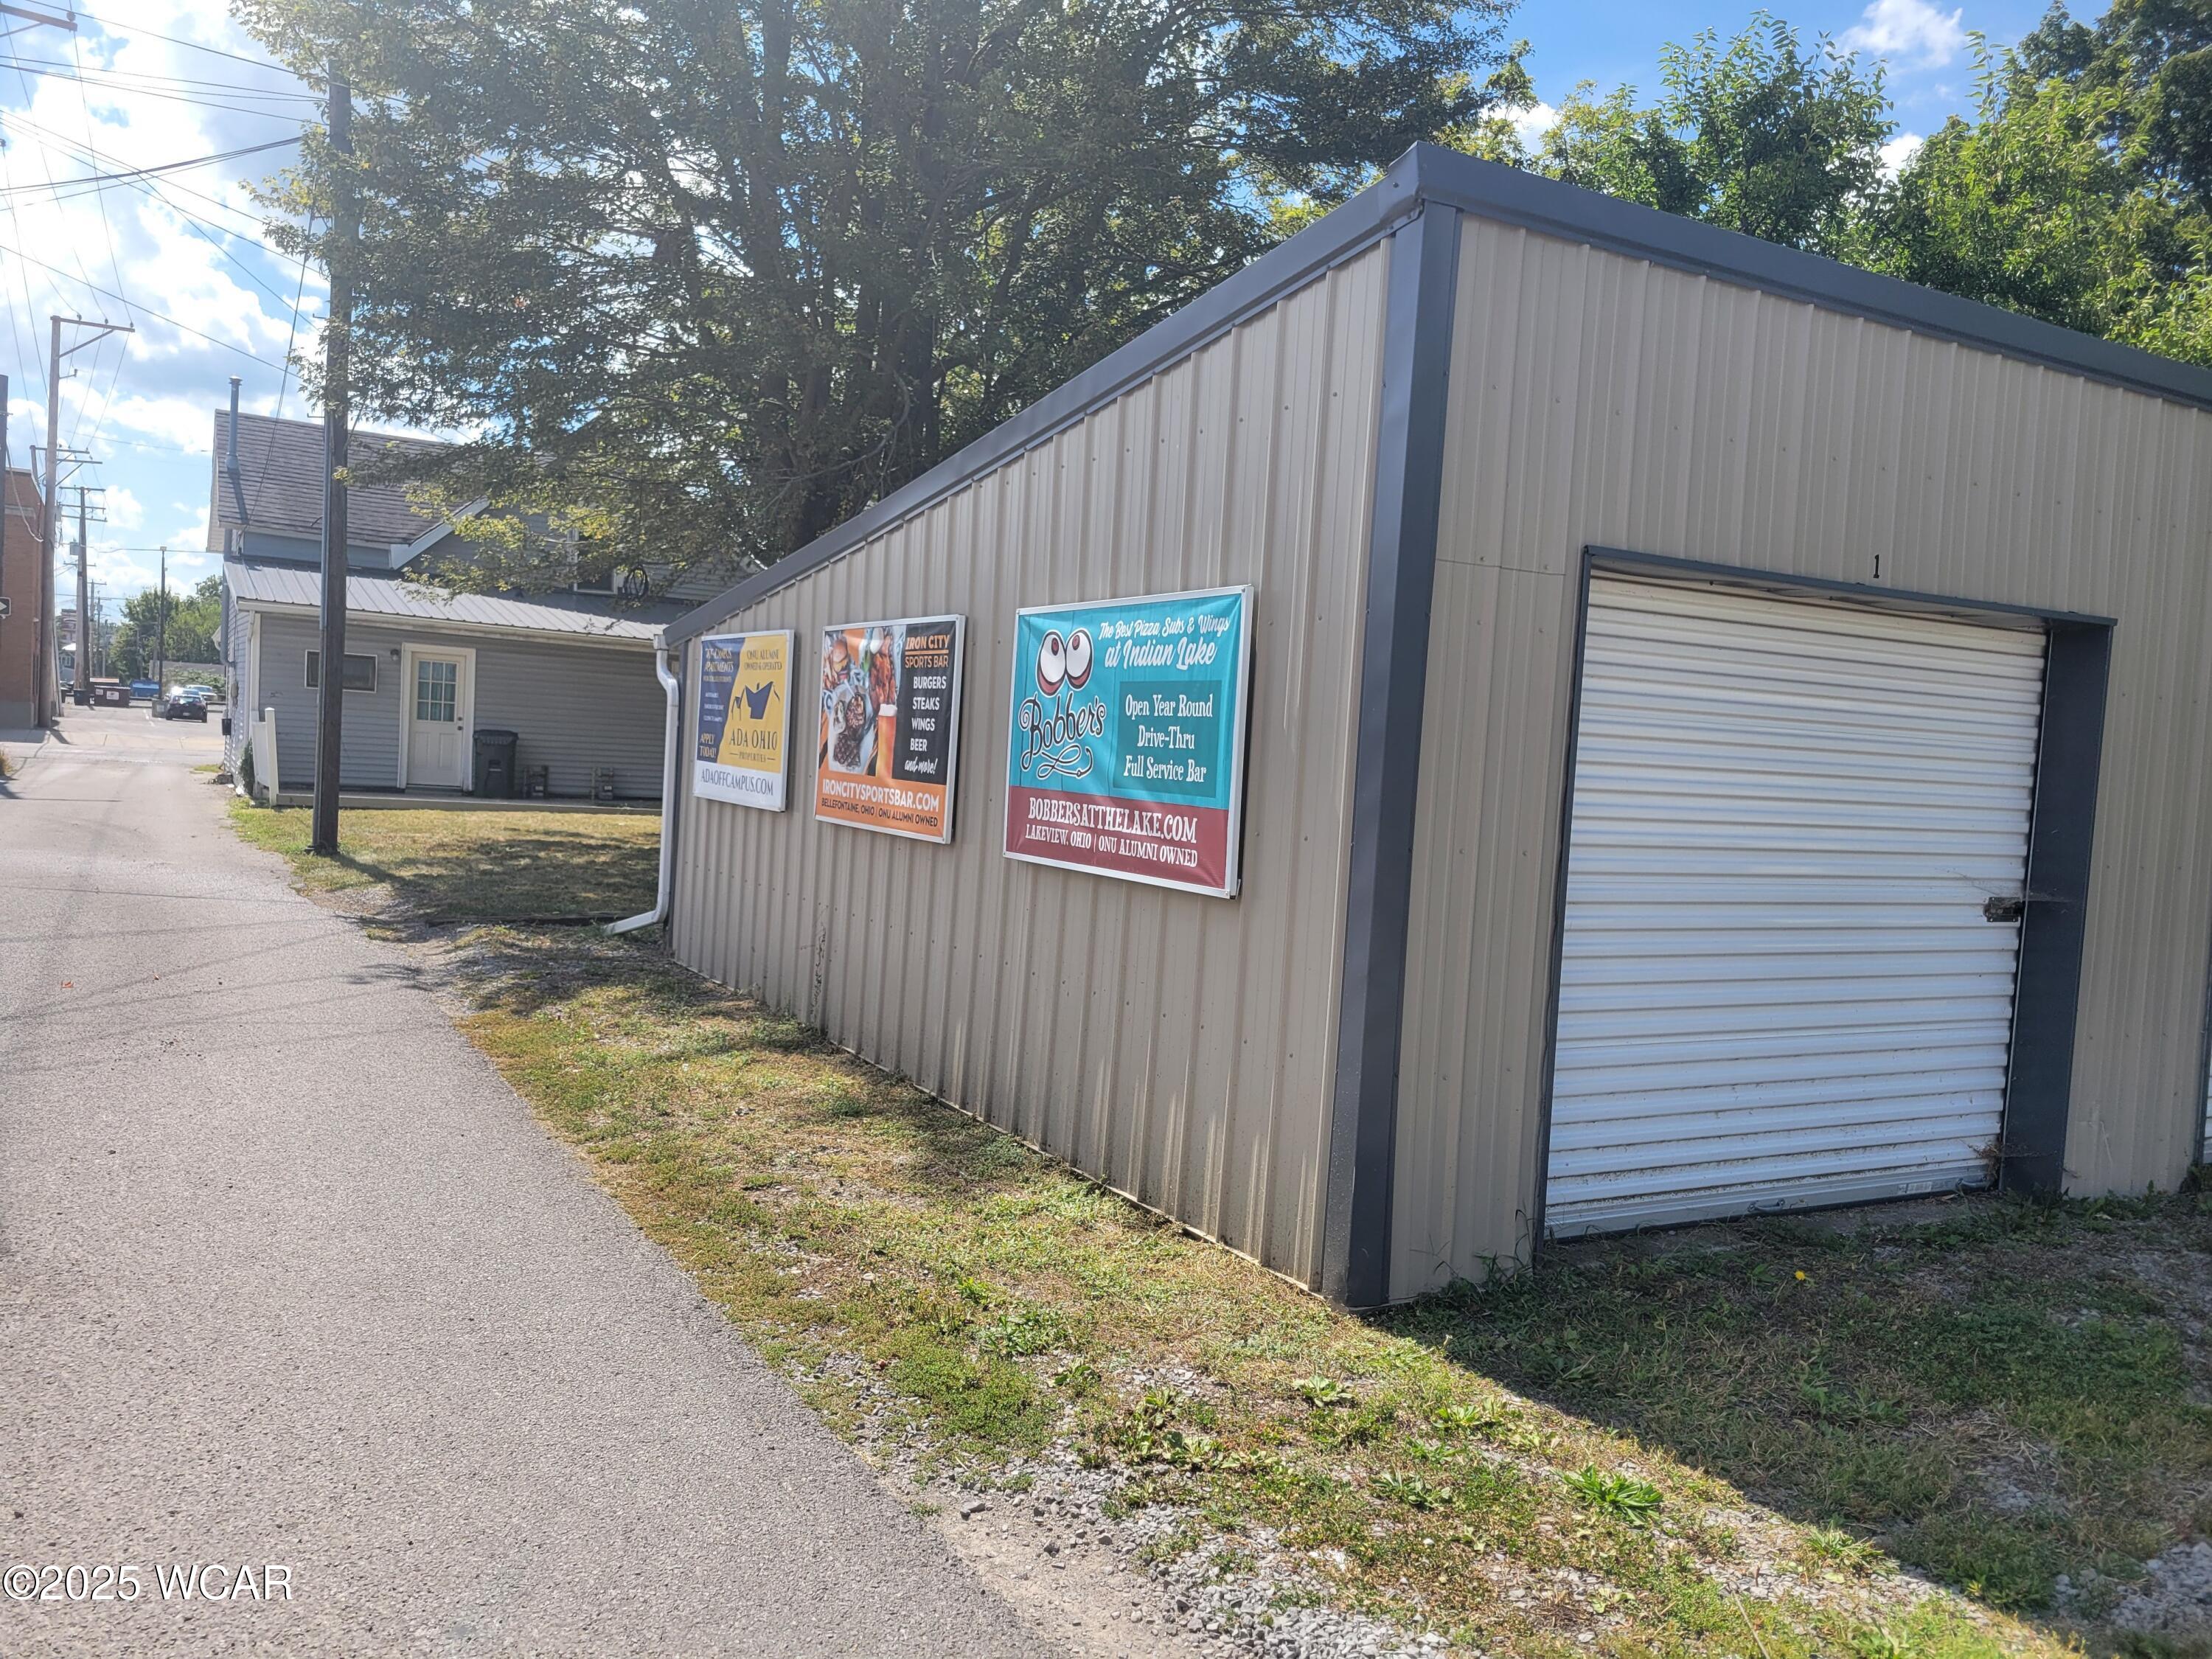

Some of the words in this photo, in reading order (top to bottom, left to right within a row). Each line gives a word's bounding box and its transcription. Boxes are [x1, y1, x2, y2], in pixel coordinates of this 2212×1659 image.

[1874, 554, 1879, 579] 1
[1099, 622, 1113, 640] The
[1115, 620, 1133, 639] Best
[1134, 619, 1161, 638] Pizza,
[1162, 616, 1185, 637] Subs
[1187, 616, 1194, 634] &
[1198, 614, 1231, 637] Wings
[905, 636, 928, 650] IRON
[928, 635, 950, 649] CITY
[1105, 641, 1121, 667] at
[1122, 639, 1177, 669] Indian
[1175, 636, 1217, 670] Lake
[905, 655, 932, 668] SPORTS
[933, 655, 949, 667] BAR
[913, 675, 947, 689] BURGERS
[912, 697, 940, 710] STEAKS
[1125, 694, 1150, 720] Open
[1152, 695, 1176, 716] Year
[1178, 693, 1213, 717] Round
[911, 717, 936, 731] WINGS
[1018, 691, 1107, 771] Bobber's
[700, 733, 715, 745] APPLY
[729, 728, 748, 747] ADA
[751, 729, 778, 751] OHIO
[910, 737, 928, 751] BEER
[1137, 725, 1194, 749] Drive-Thru
[739, 751, 766, 762] PROPERTIES
[904, 756, 918, 773] and
[918, 757, 938, 775] more!
[1124, 755, 1144, 777] Full
[1147, 756, 1184, 781] Service
[1186, 759, 1207, 782] Bar
[701, 768, 773, 796] ADAOFFCAMPUS.COM
[822, 779, 939, 812] IRONCITYSPORTSBAR.COM
[821, 798, 860, 815] BELLEFONTAINE,
[860, 805, 875, 815] OHIO
[878, 807, 891, 818] ONU
[891, 810, 914, 824] ALUMNI
[915, 814, 939, 827] OWNED
[1028, 797, 1197, 844] BOBBERSATTHELAKE.COM
[1071, 831, 1092, 849] OHIO
[1098, 835, 1118, 853] ONU
[1119, 839, 1158, 861] ALUMNI
[1159, 845, 1197, 868] OWNED
